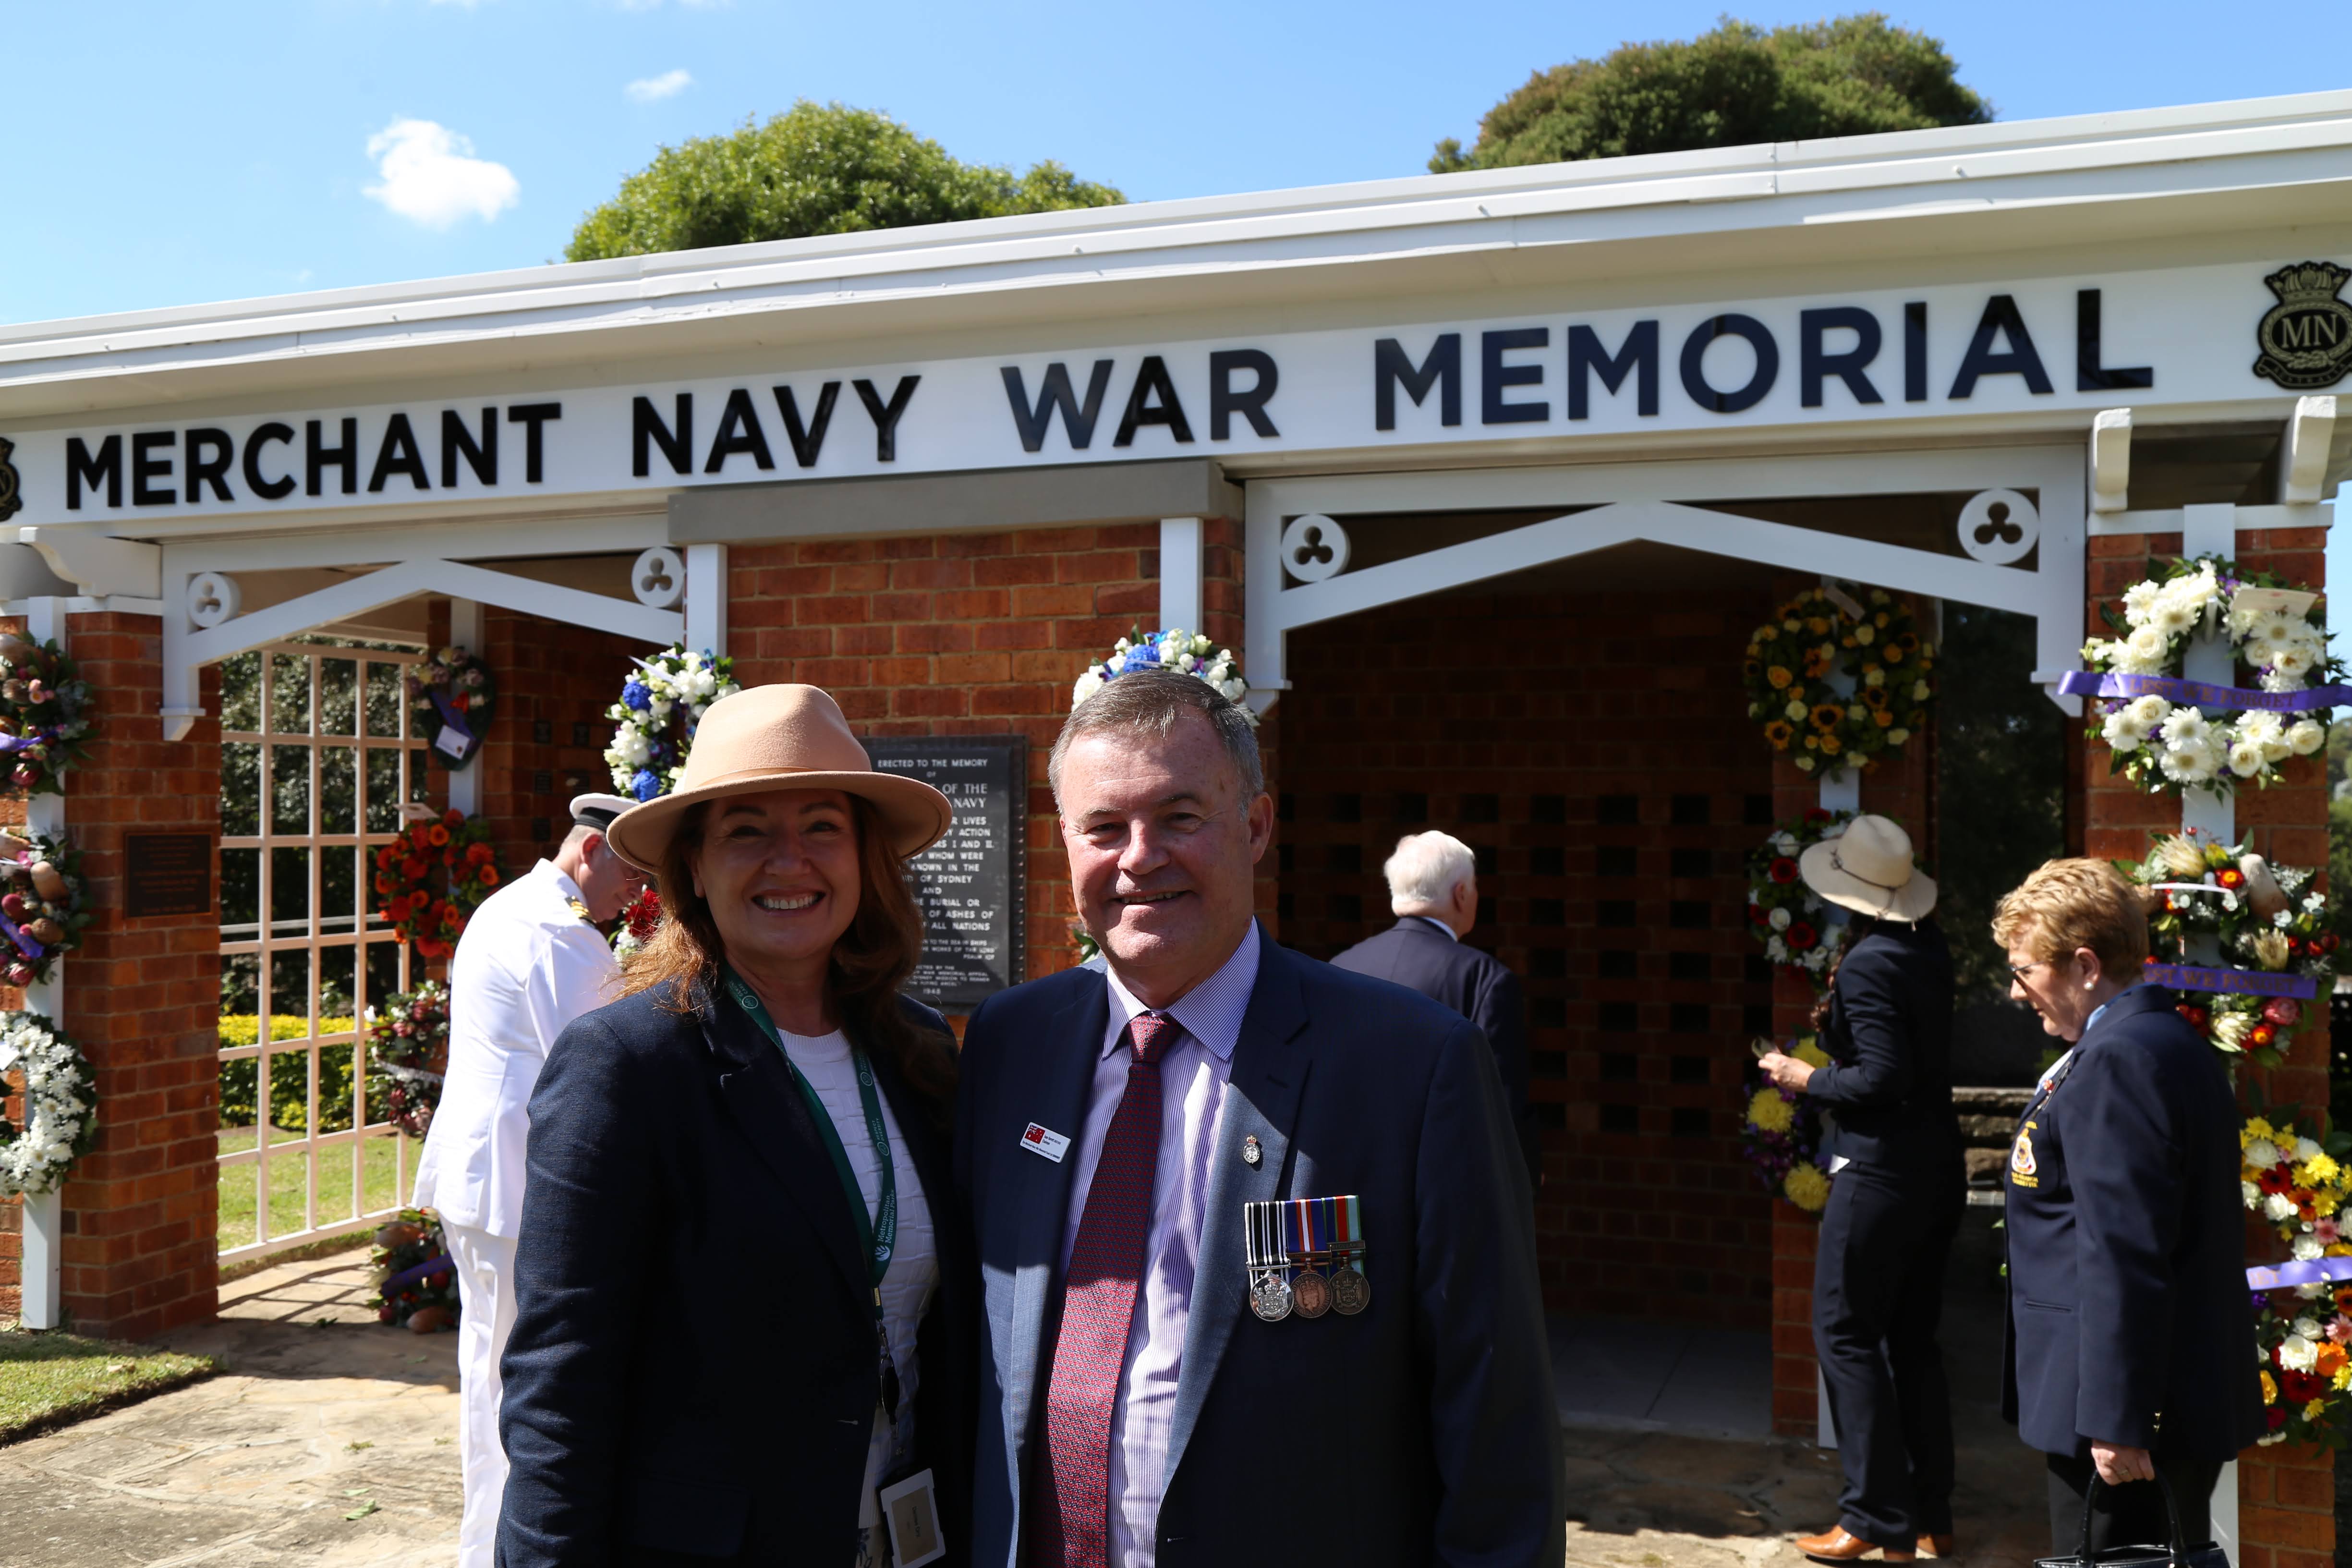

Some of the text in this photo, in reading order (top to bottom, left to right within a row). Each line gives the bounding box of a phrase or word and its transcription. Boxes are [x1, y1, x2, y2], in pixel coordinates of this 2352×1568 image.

[2281, 314, 2338, 349] MN
[66, 289, 2153, 510] MERCHANT NAVY WAR MEMORIAL
[2130, 678, 2297, 708] LEST WE FORGET
[877, 758, 988, 768] ERECTED TO THE MEMORY
[942, 783, 958, 794] OF
[964, 783, 988, 794] THE
[953, 798, 986, 808] NAVY
[962, 816, 987, 825] LIVES
[959, 828, 991, 836] ACTION
[960, 840, 981, 848] AND
[959, 852, 983, 860] WERE
[948, 863, 958, 872] IN
[963, 863, 980, 872] THE
[937, 875, 973, 883] SYDNEY
[922, 887, 942, 895] AND
[930, 898, 961, 907] BURIAL
[966, 899, 980, 907] OR
[945, 910, 975, 919] ASHES
[981, 911, 994, 919] OF
[931, 922, 947, 930] ALL
[952, 922, 991, 931] NATIONS
[2182, 970, 2216, 988] WE
[2221, 973, 2297, 994] FORGET
[877, 1195, 890, 1242] Metropolitan
[885, 1209, 895, 1244] Memorial
